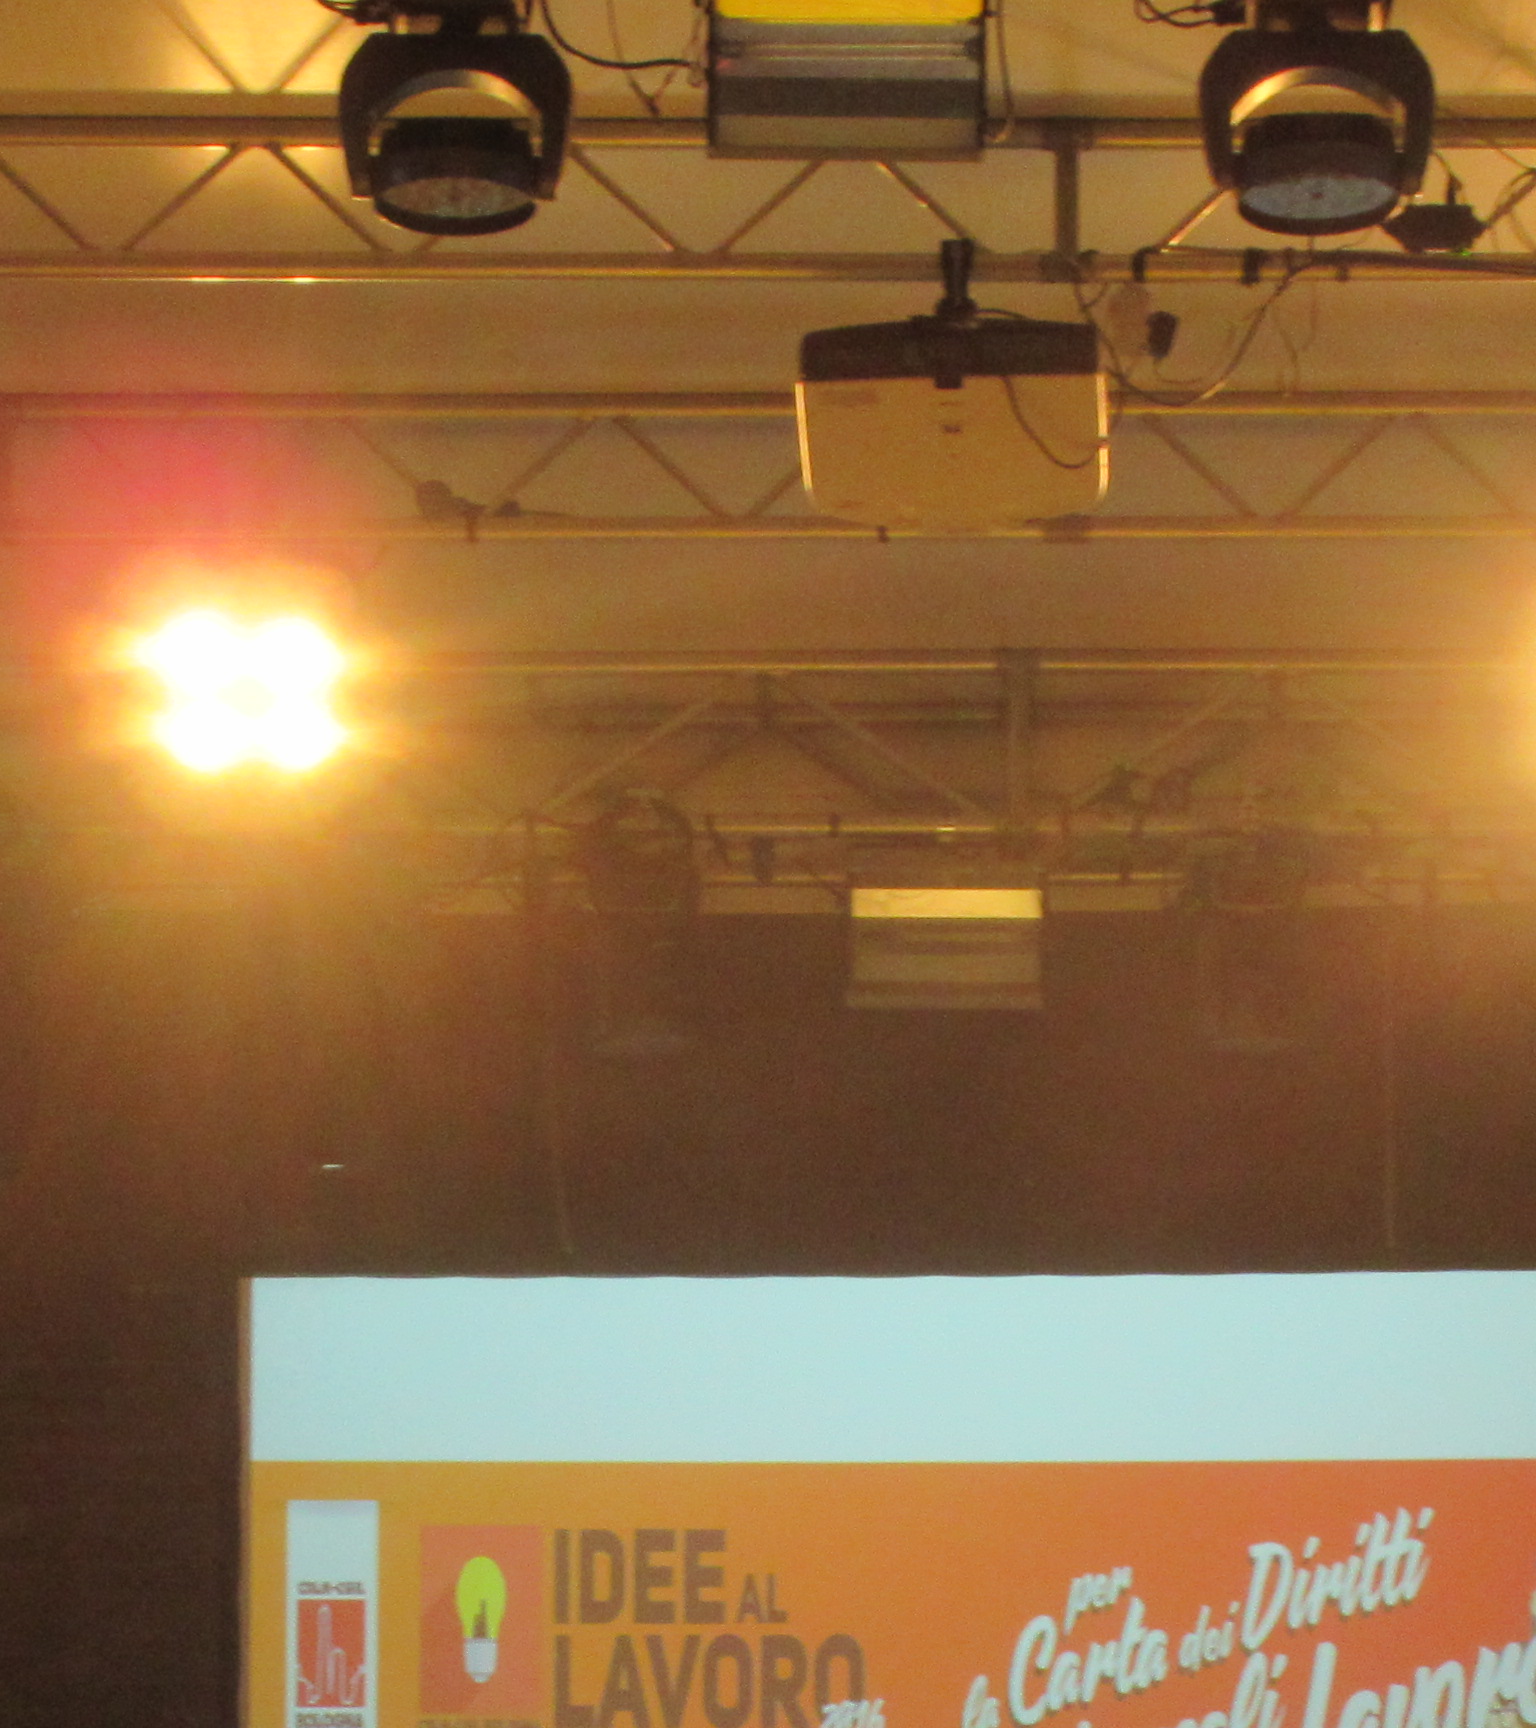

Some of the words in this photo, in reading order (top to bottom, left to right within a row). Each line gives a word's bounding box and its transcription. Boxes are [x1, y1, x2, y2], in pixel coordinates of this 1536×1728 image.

[554, 1529, 727, 1625] IDEE
[736, 1573, 789, 1625] AL
[1008, 1596, 1168, 1728] Carta
[1179, 1603, 1239, 1675] dei
[1240, 1507, 1435, 1650] Diritti
[1065, 1566, 1132, 1634] per
